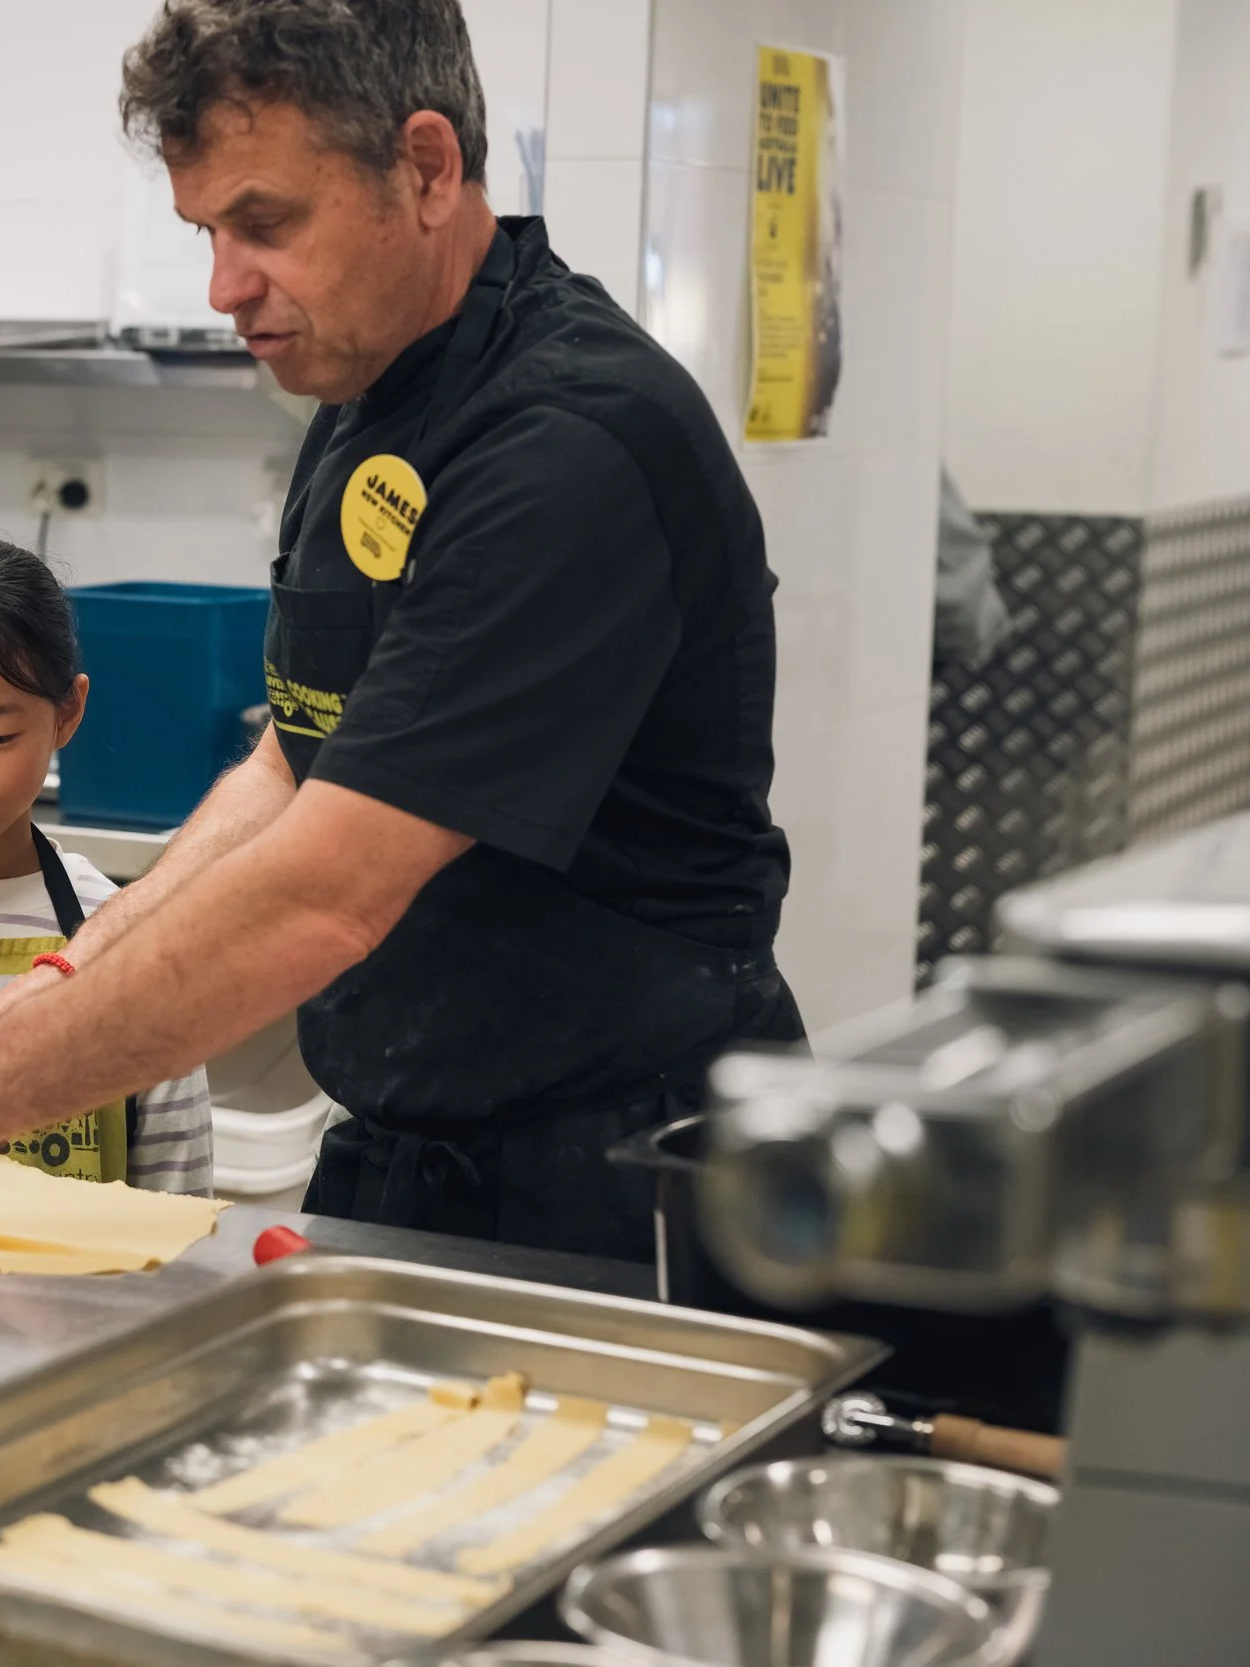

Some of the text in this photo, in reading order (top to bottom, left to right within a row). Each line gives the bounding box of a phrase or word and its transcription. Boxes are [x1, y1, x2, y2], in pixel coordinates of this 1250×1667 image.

[760, 82, 801, 113] UNITE
[757, 154, 797, 195] LIVE
[366, 474, 419, 525] JAMES
